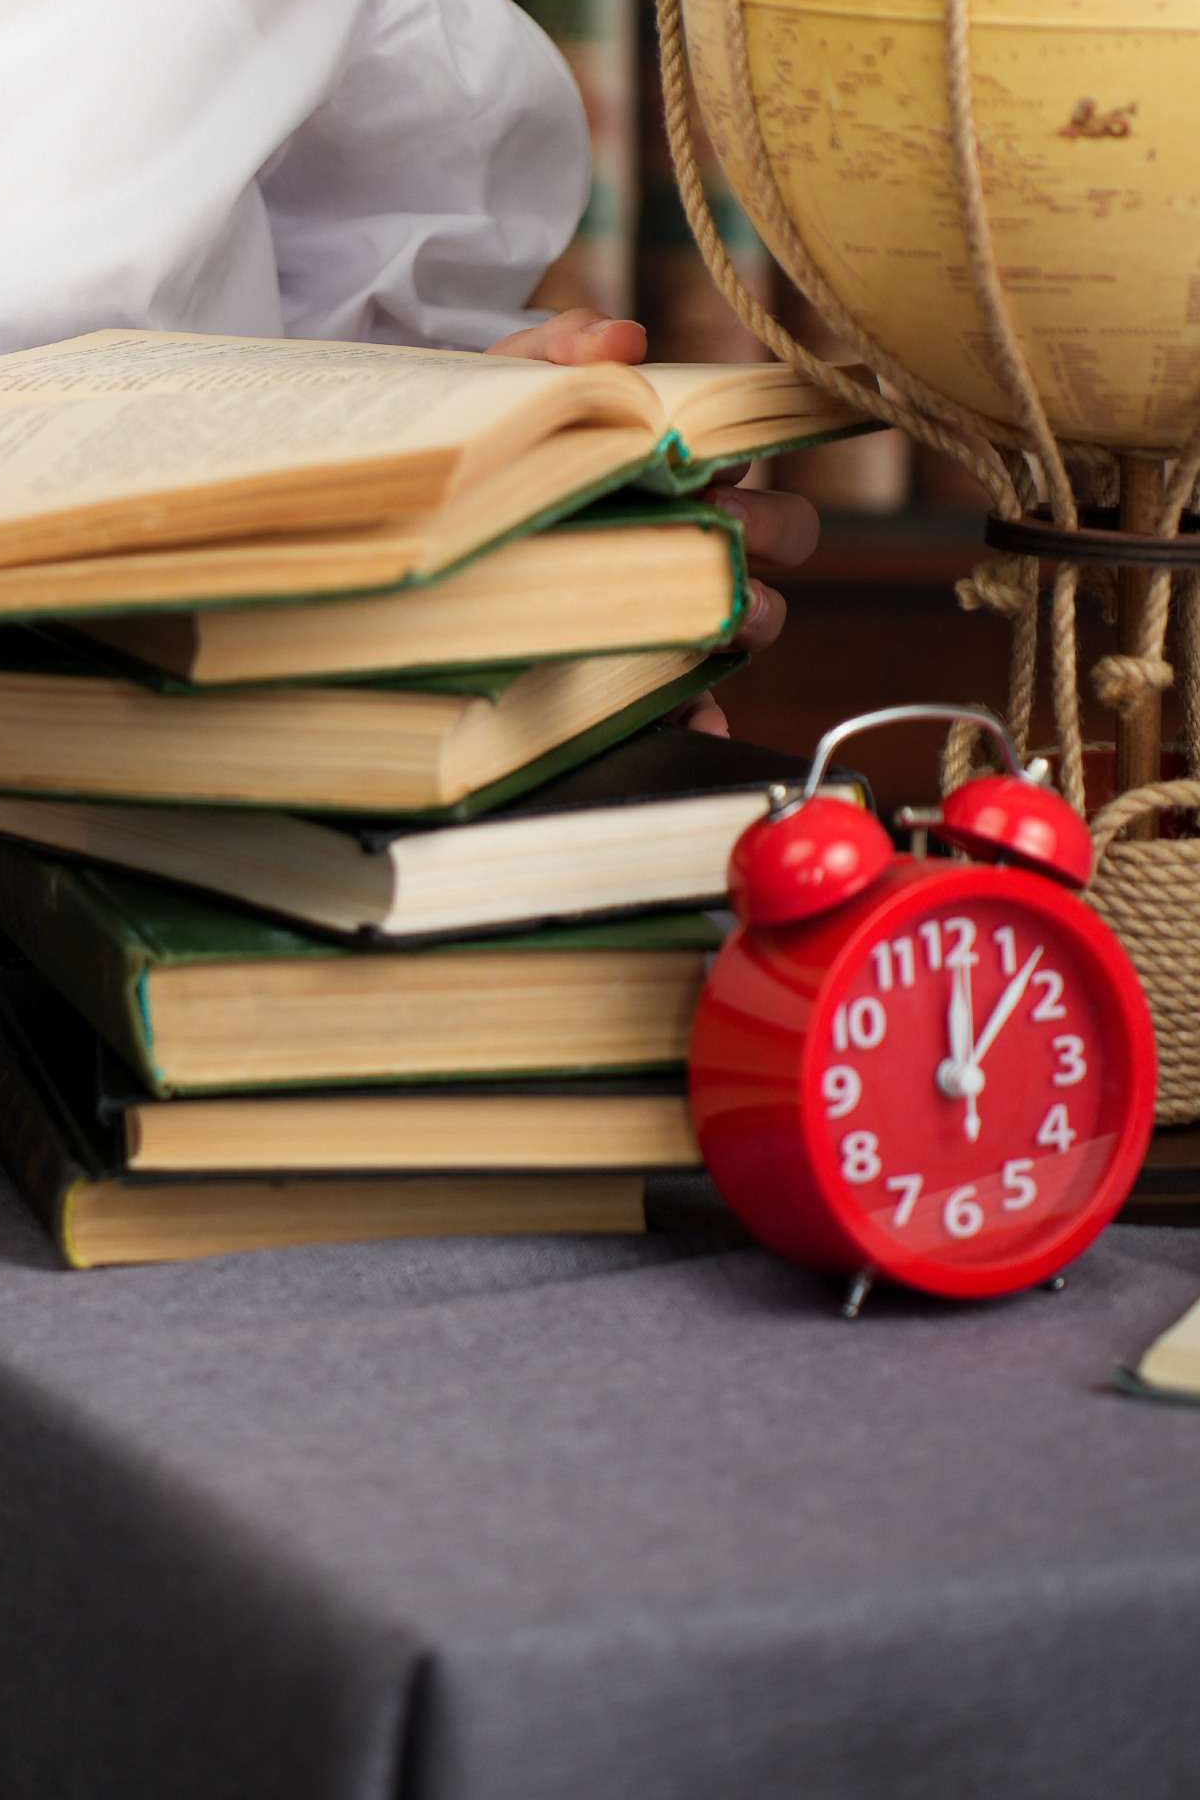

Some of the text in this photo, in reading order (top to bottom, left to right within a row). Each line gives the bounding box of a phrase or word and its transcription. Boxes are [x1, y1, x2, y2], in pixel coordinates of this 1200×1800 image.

[871, 936, 915, 991] 11
[918, 916, 979, 971] 12
[993, 925, 1017, 975] 1
[1030, 970, 1066, 1021] 2
[832, 996, 887, 1052] 10
[1052, 1034, 1087, 1086] 3
[822, 1064, 862, 1119] 9
[1036, 1103, 1075, 1153] 4
[841, 1130, 882, 1184] 8
[885, 1173, 923, 1227] 7
[1001, 1158, 1037, 1211] 5
[943, 1185, 985, 1239] 6
